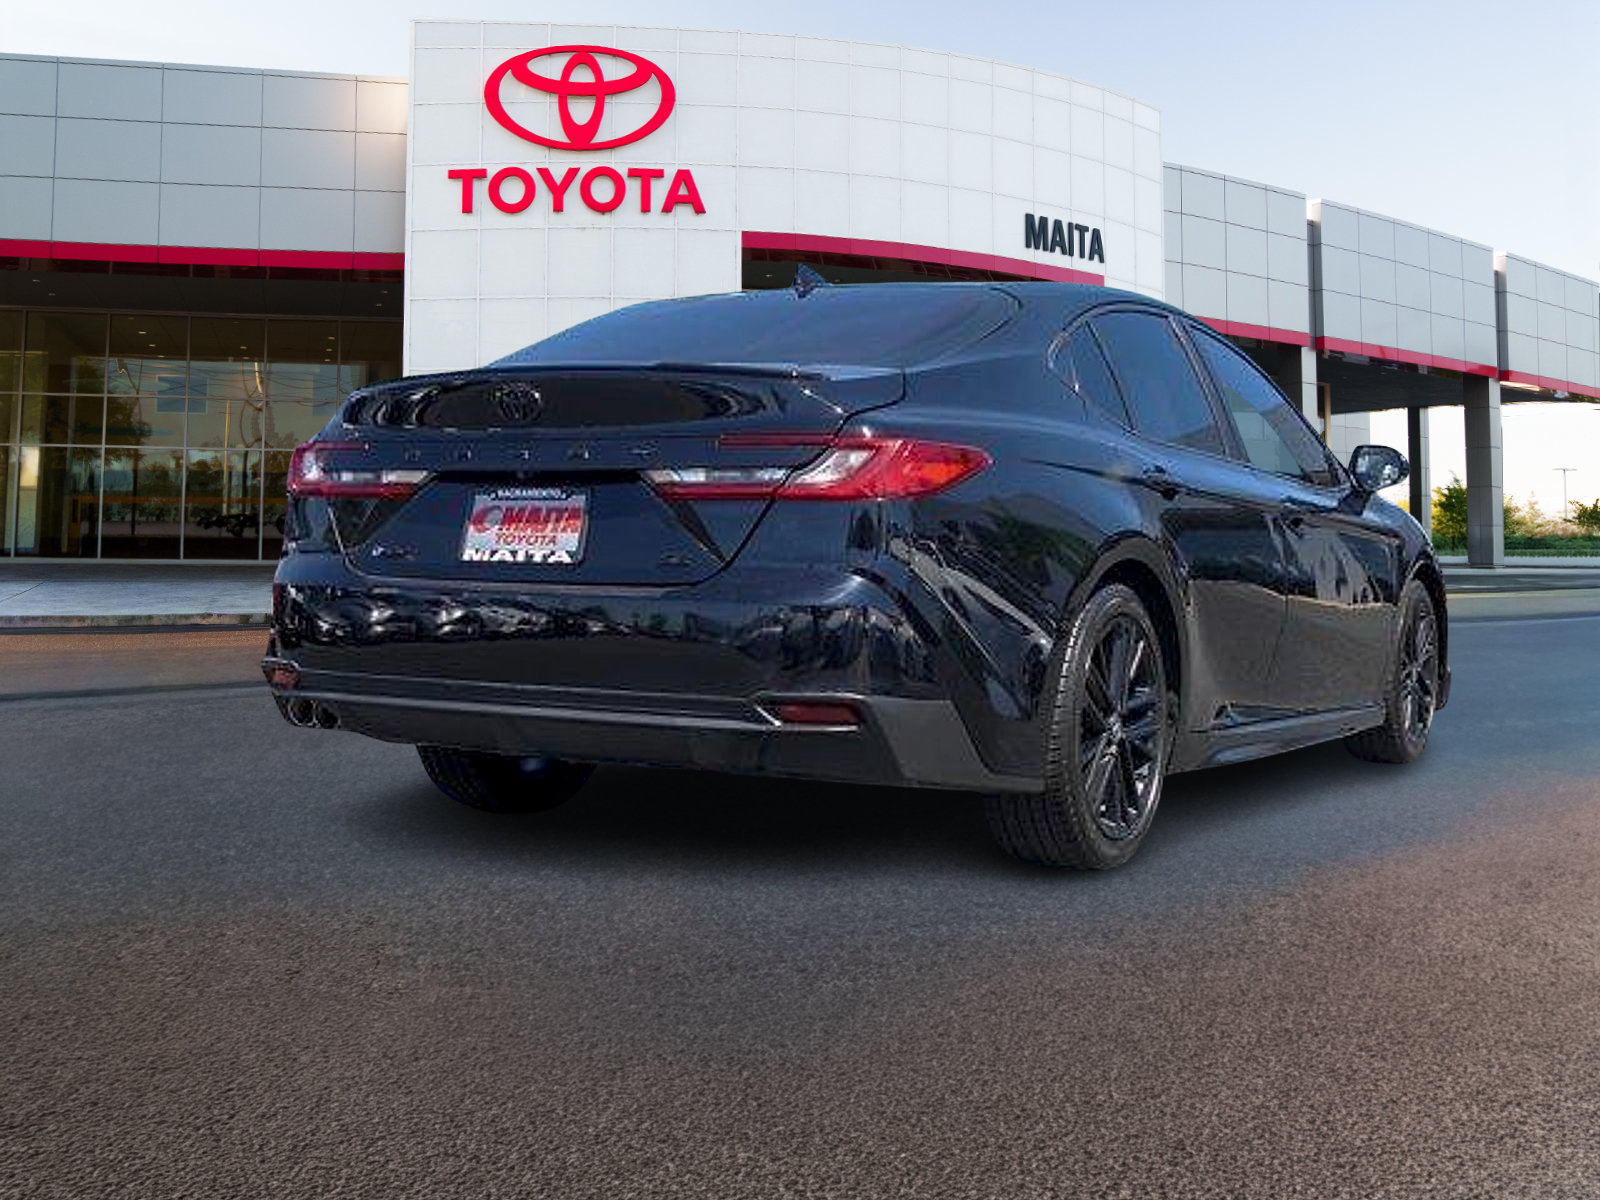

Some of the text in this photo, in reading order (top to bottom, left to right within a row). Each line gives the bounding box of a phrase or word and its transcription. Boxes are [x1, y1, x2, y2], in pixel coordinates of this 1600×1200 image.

[448, 167, 705, 213] TOYOTA
[1025, 214, 1105, 263] MAITA
[495, 532, 557, 545] TOYOTA
[462, 549, 574, 563] MAITA
